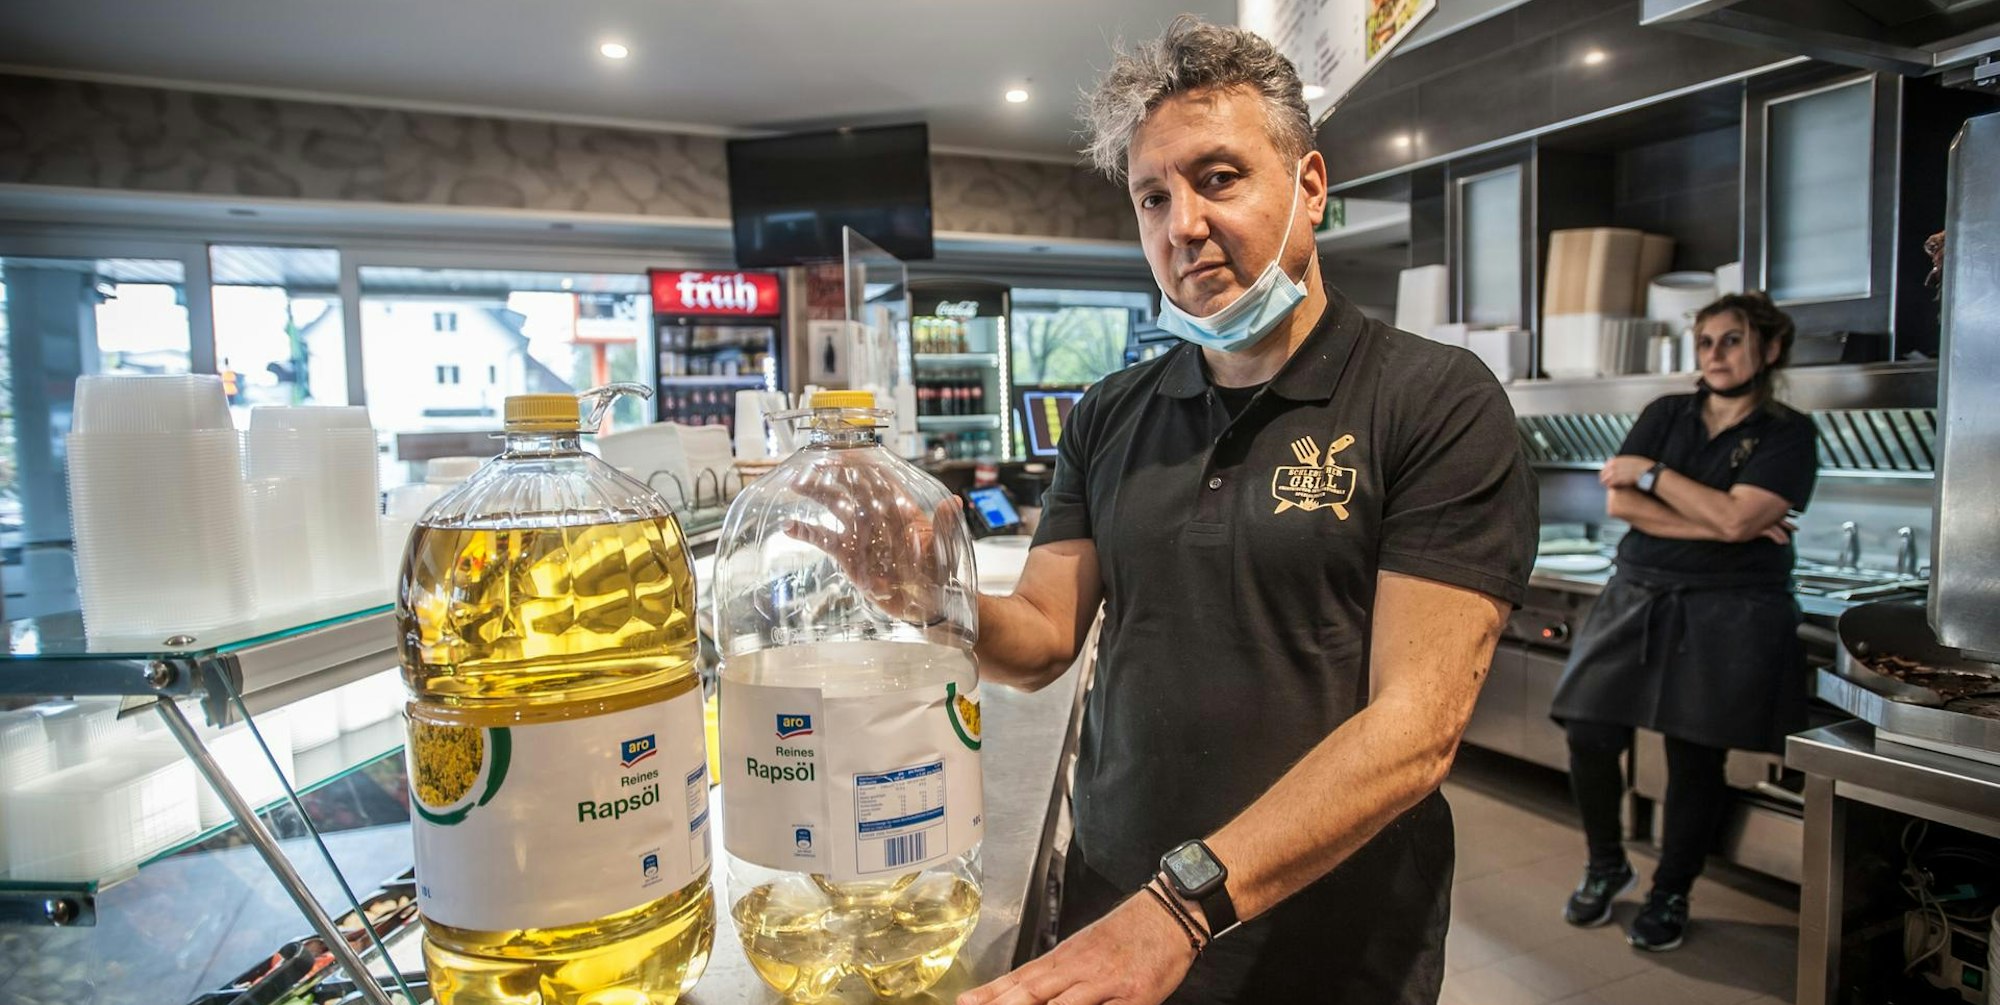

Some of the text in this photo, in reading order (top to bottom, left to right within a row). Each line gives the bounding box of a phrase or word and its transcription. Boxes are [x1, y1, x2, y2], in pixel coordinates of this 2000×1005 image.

[676, 272, 758, 313] früh
[783, 717, 804, 727] aro
[628, 739, 650, 754] aro
[776, 746, 815, 757] Reines
[621, 769, 659, 787] Reines
[747, 757, 815, 784] Rapsöl
[577, 784, 660, 823] Rapsöl
